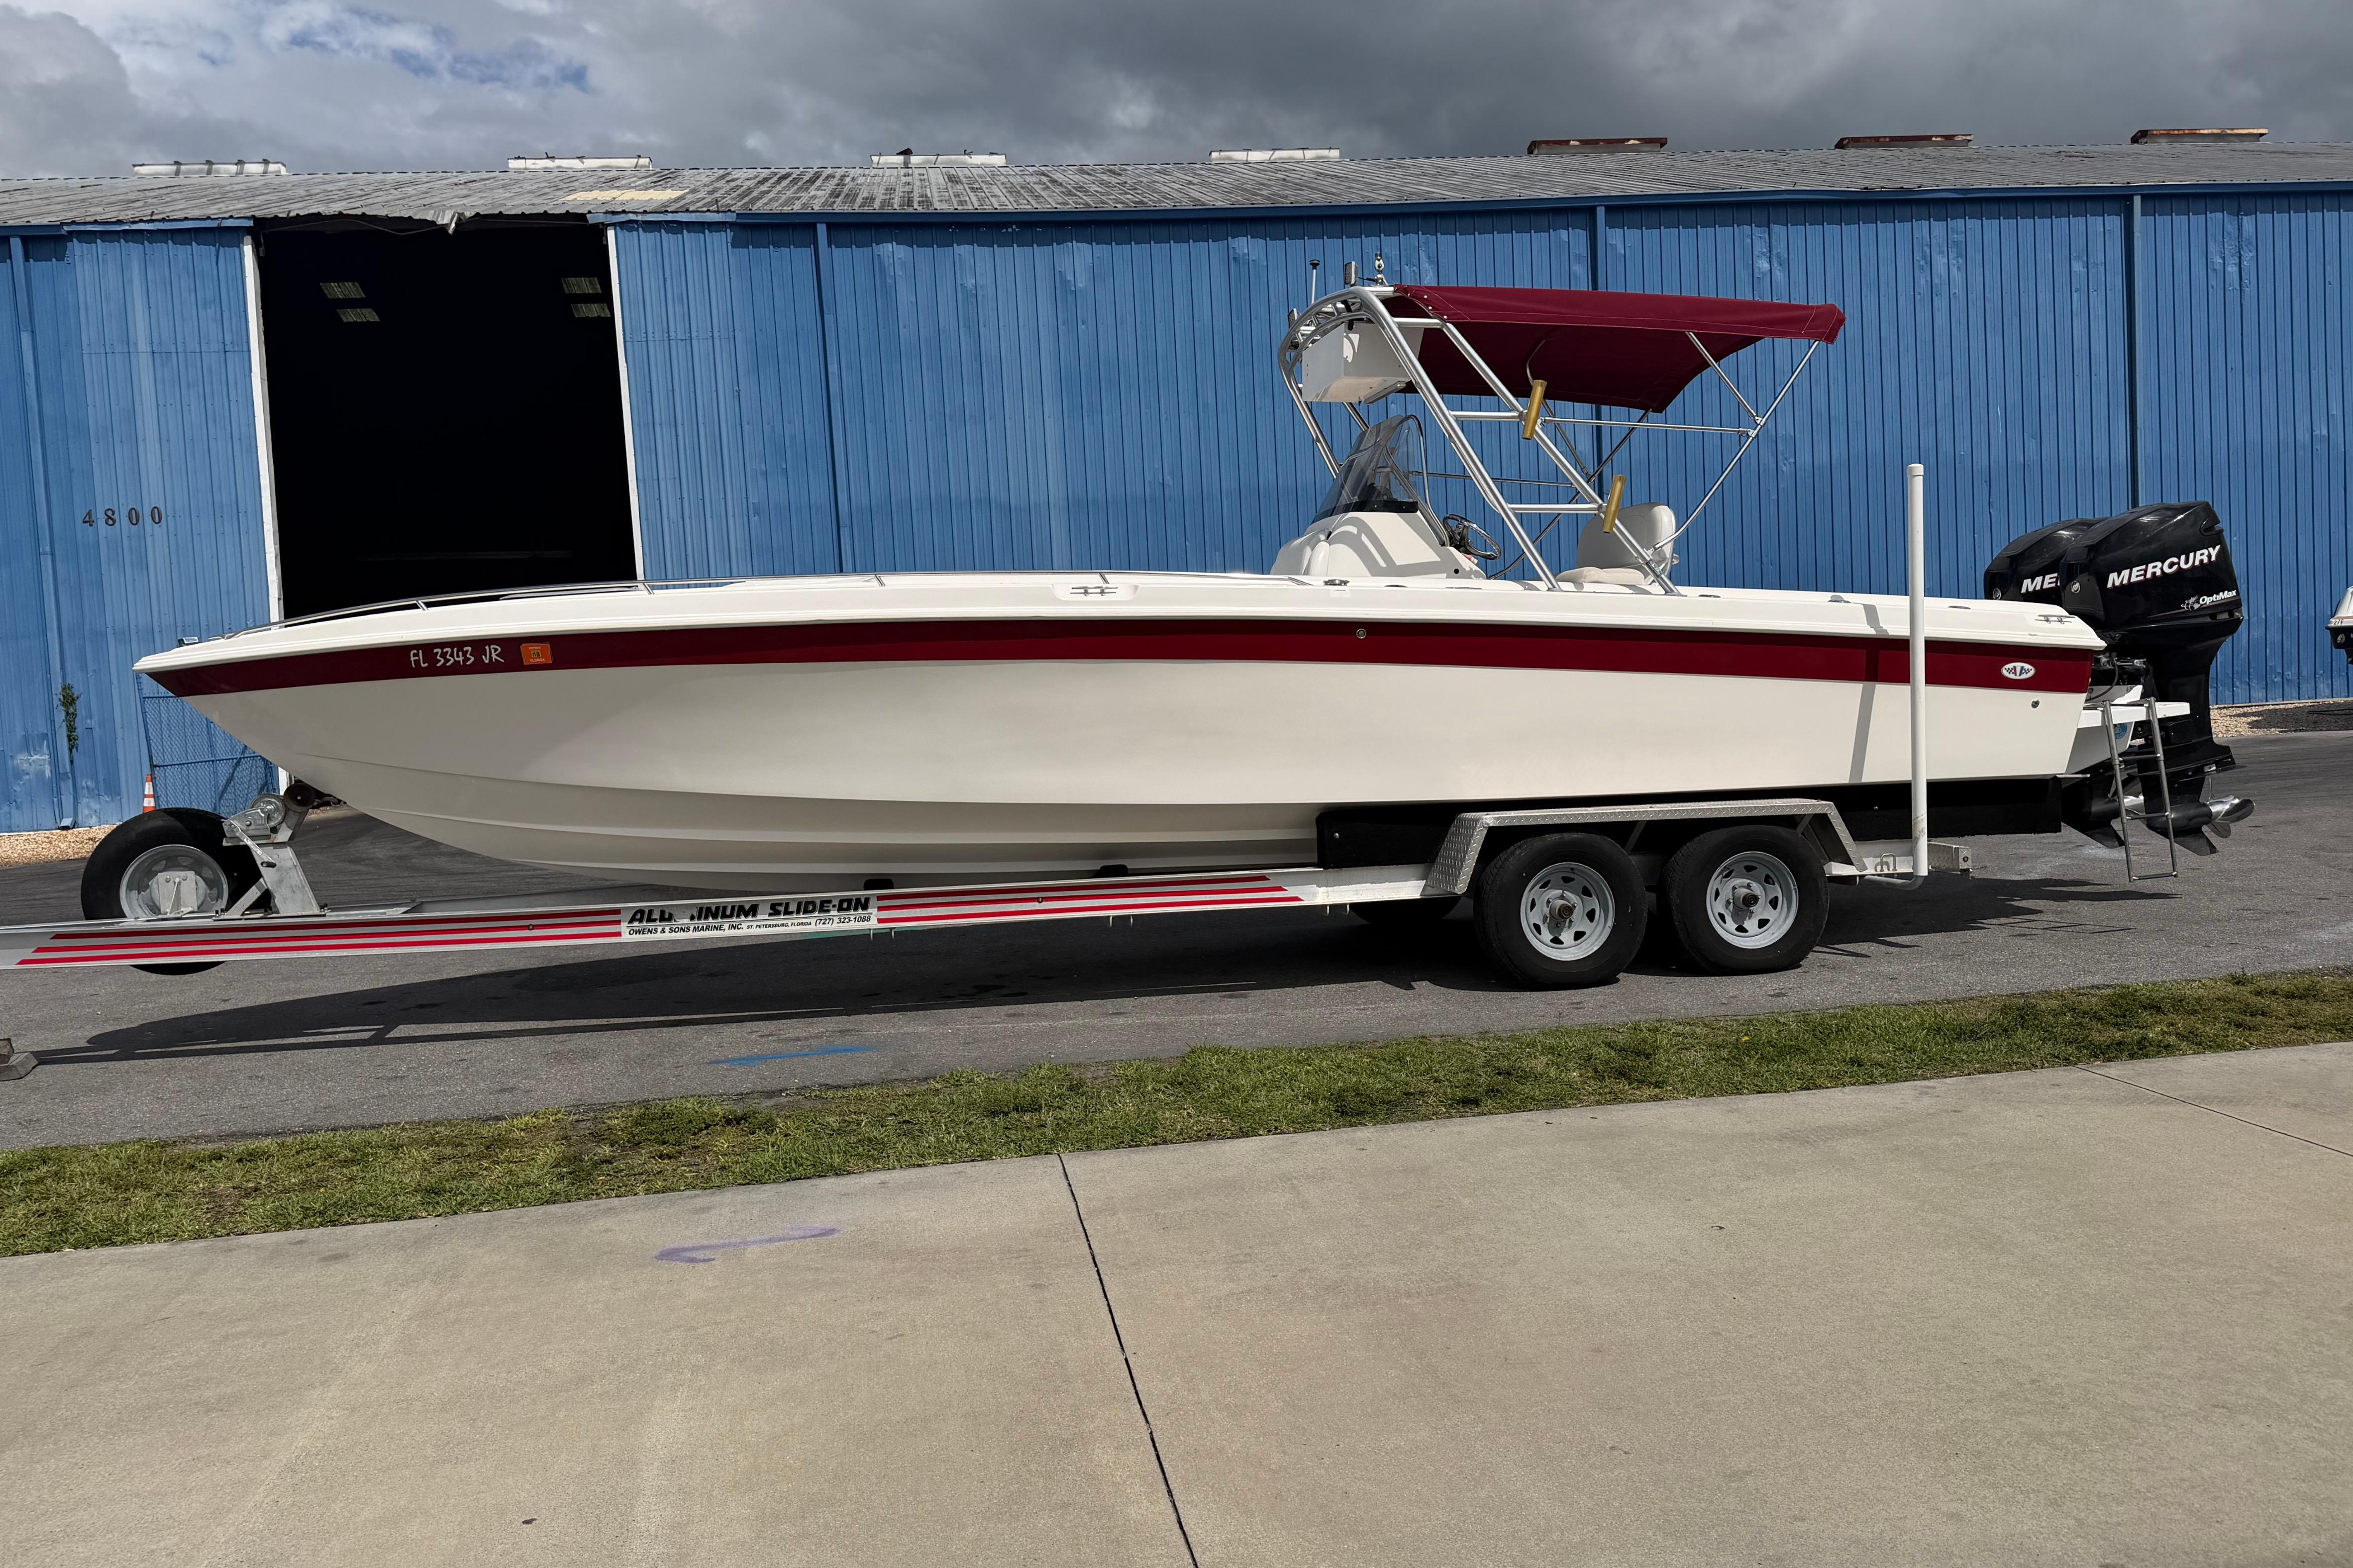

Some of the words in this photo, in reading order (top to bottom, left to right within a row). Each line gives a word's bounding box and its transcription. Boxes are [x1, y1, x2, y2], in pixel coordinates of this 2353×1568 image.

[82, 506, 163, 527] 4800
[2107, 545, 2221, 588] MERCURY
[2021, 573, 2060, 593] ME
[2199, 590, 2237, 605] OptiMax
[410, 650, 428, 668] FL
[433, 647, 474, 666] 3343
[482, 645, 505, 663] JR
[627, 903, 760, 924] ALUINUM
[768, 897, 871, 917] SLIDE-ON
[692, 924, 725, 933] MARINE,
[815, 918, 834, 926] (727)
[836, 916, 871, 924] 323-1088
